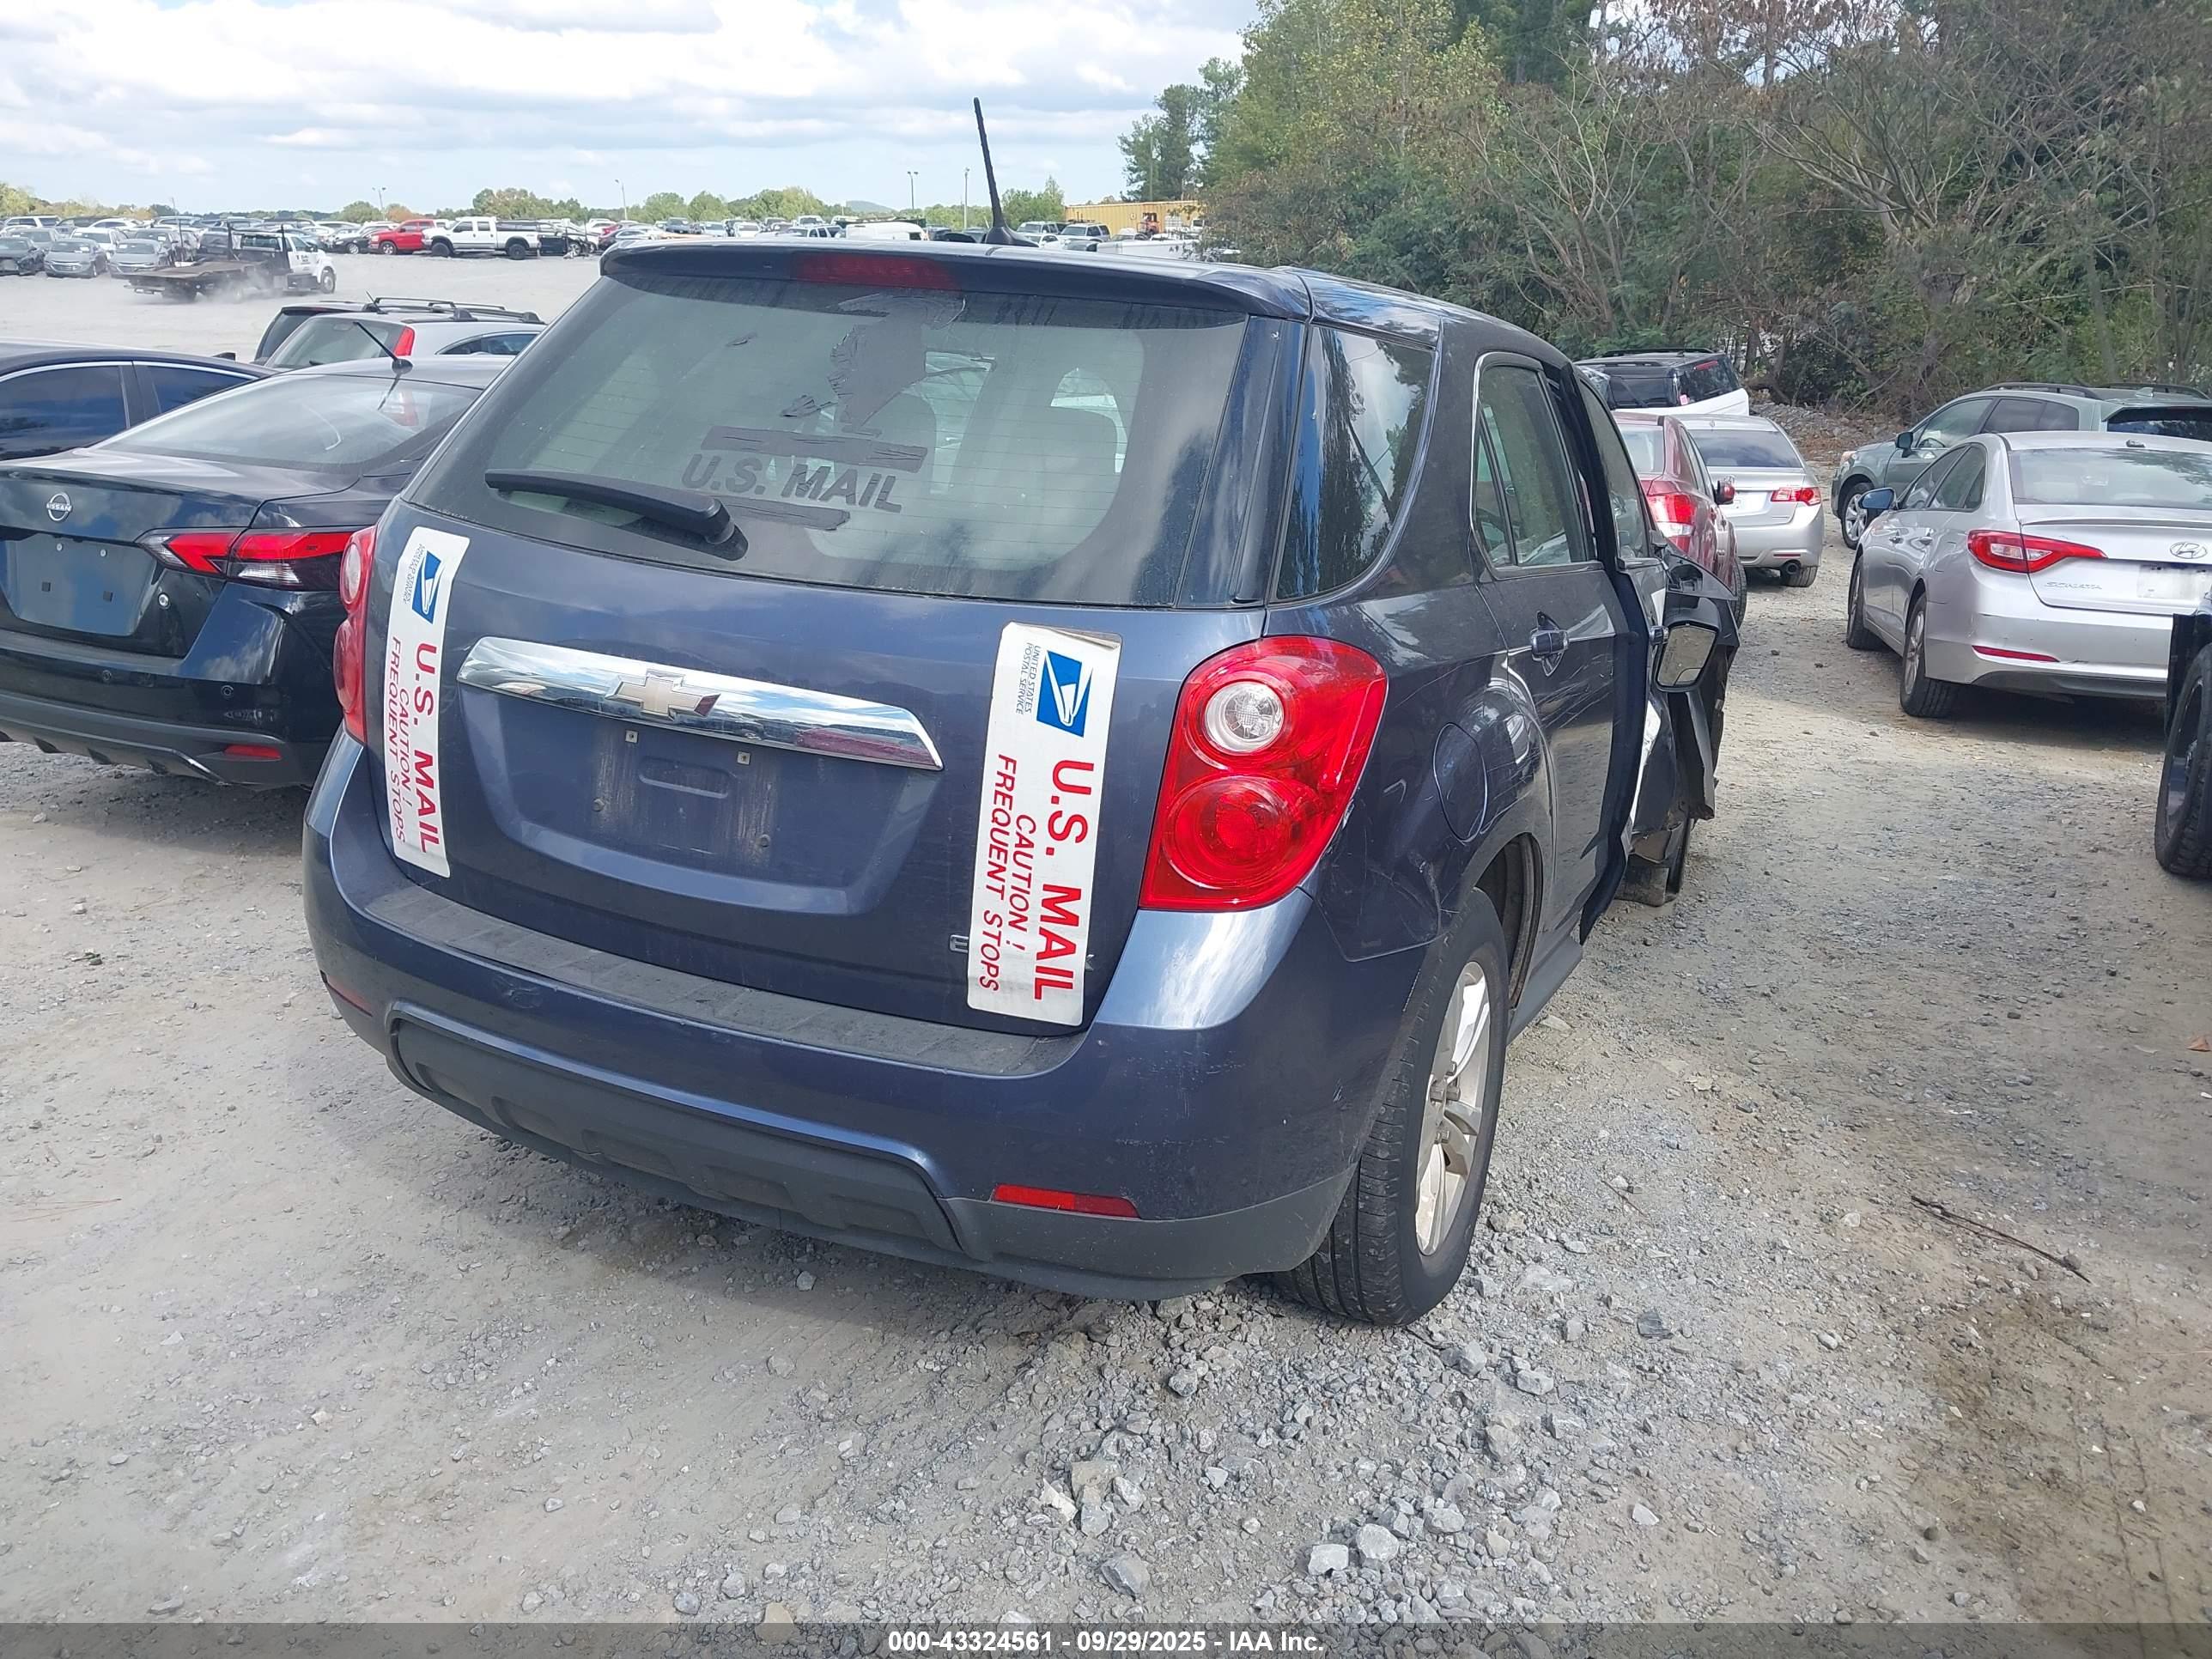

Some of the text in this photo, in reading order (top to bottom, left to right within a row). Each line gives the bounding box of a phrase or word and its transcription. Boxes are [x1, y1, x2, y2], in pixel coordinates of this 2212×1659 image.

[46, 502, 72, 513] NISSAN
[682, 453, 902, 514] U.S. MAIL
[1016, 641, 1035, 715] POSTAL SERVICE
[1024, 645, 1042, 714] UNITED STATES
[387, 635, 406, 843] FREQUENT STOPS
[413, 642, 440, 854] U.S. MAIL
[978, 753, 1018, 992] FREQUENT STOPS
[1009, 814, 1037, 933] CAUTION
[1033, 759, 1095, 1000] U.S. MAIL
